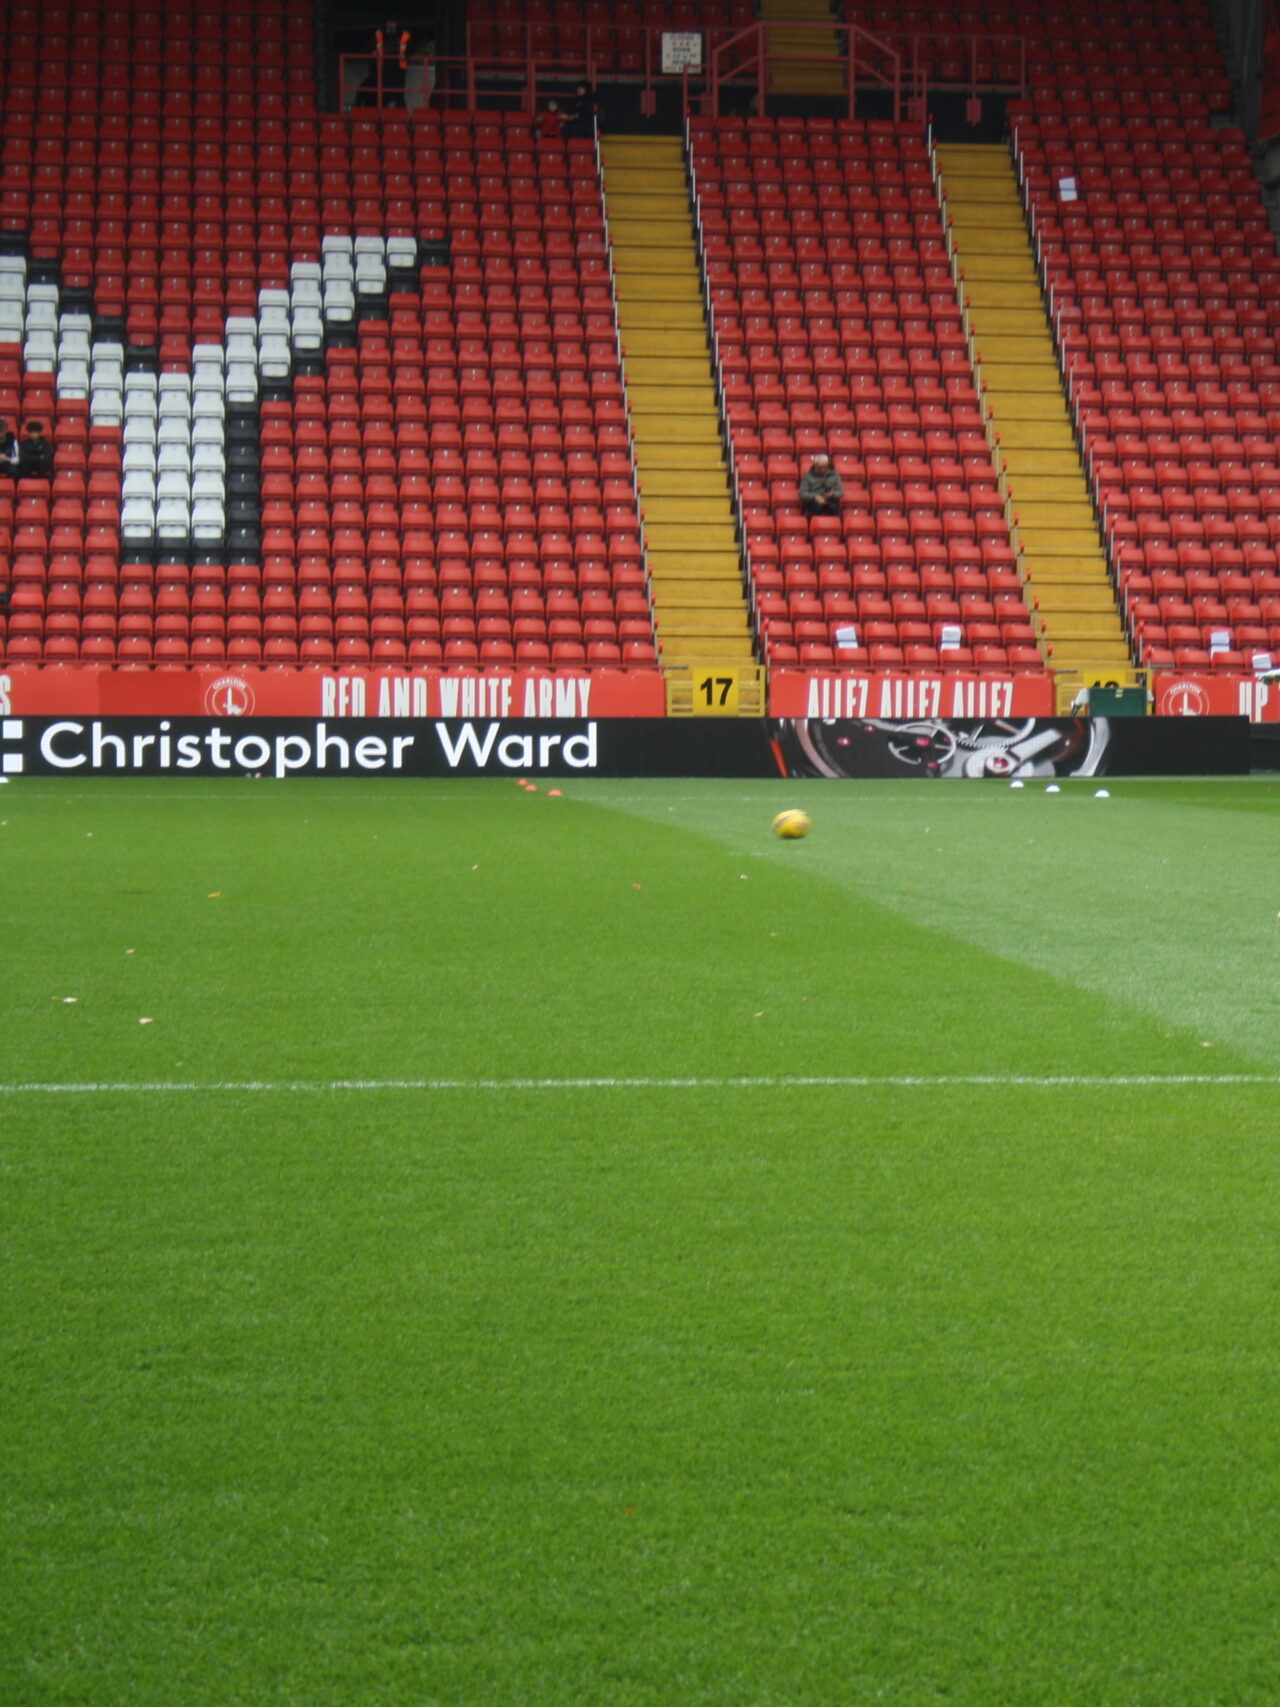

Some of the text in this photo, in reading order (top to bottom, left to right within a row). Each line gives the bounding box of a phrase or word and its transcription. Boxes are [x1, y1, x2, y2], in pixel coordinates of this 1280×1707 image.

[378, 677, 427, 717] AND
[524, 678, 592, 717] ARMY
[700, 677, 733, 706] 17
[1239, 681, 1268, 722] UP
[40, 721, 597, 778] Christopher Ward
